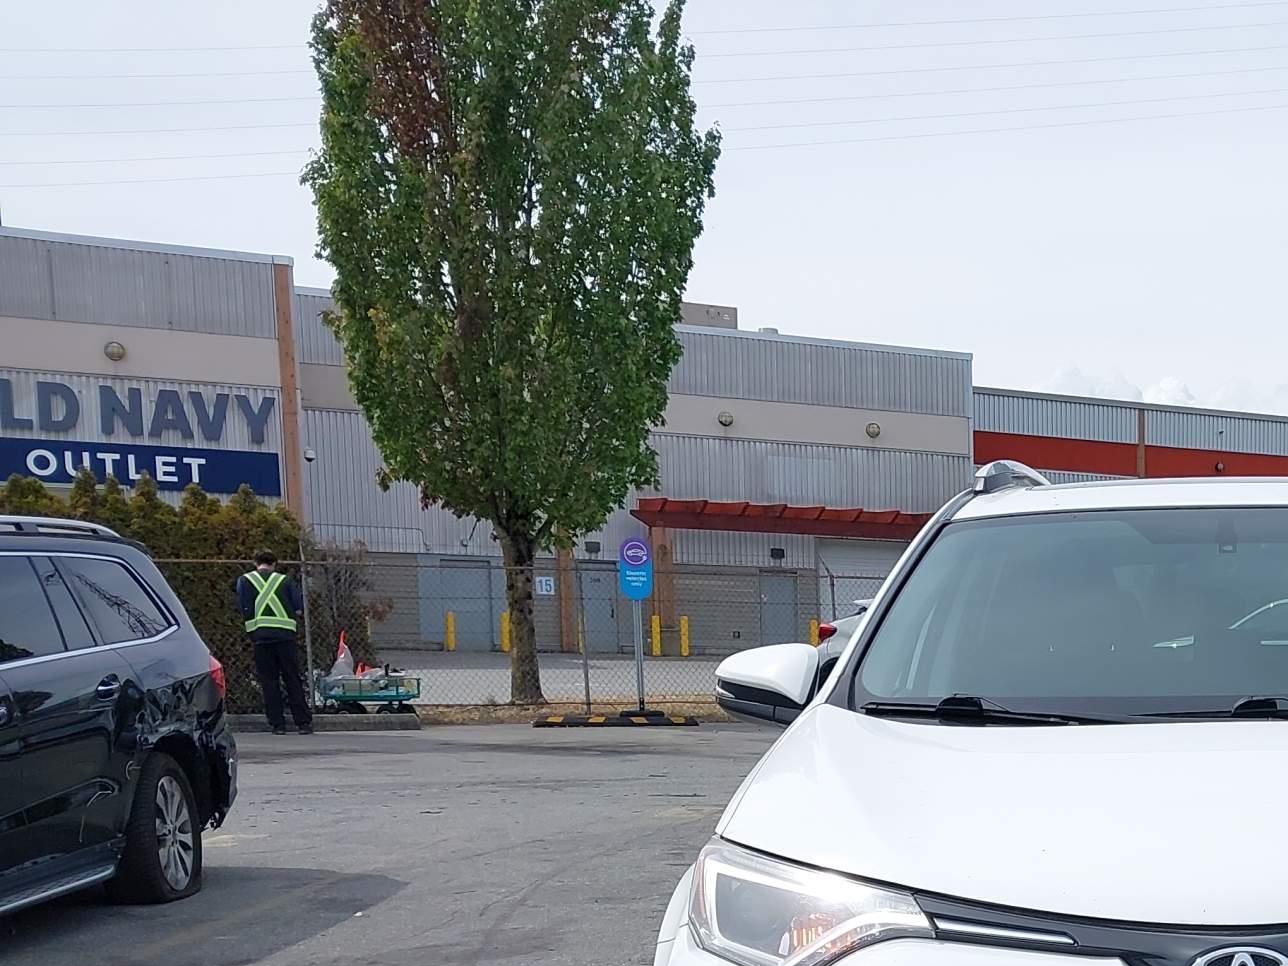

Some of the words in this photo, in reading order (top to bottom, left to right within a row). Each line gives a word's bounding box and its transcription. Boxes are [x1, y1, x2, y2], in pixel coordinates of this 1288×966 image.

[100, 385, 275, 444] NAVY
[26, 448, 207, 483] OUTLET
[537, 578, 553, 593] 15
